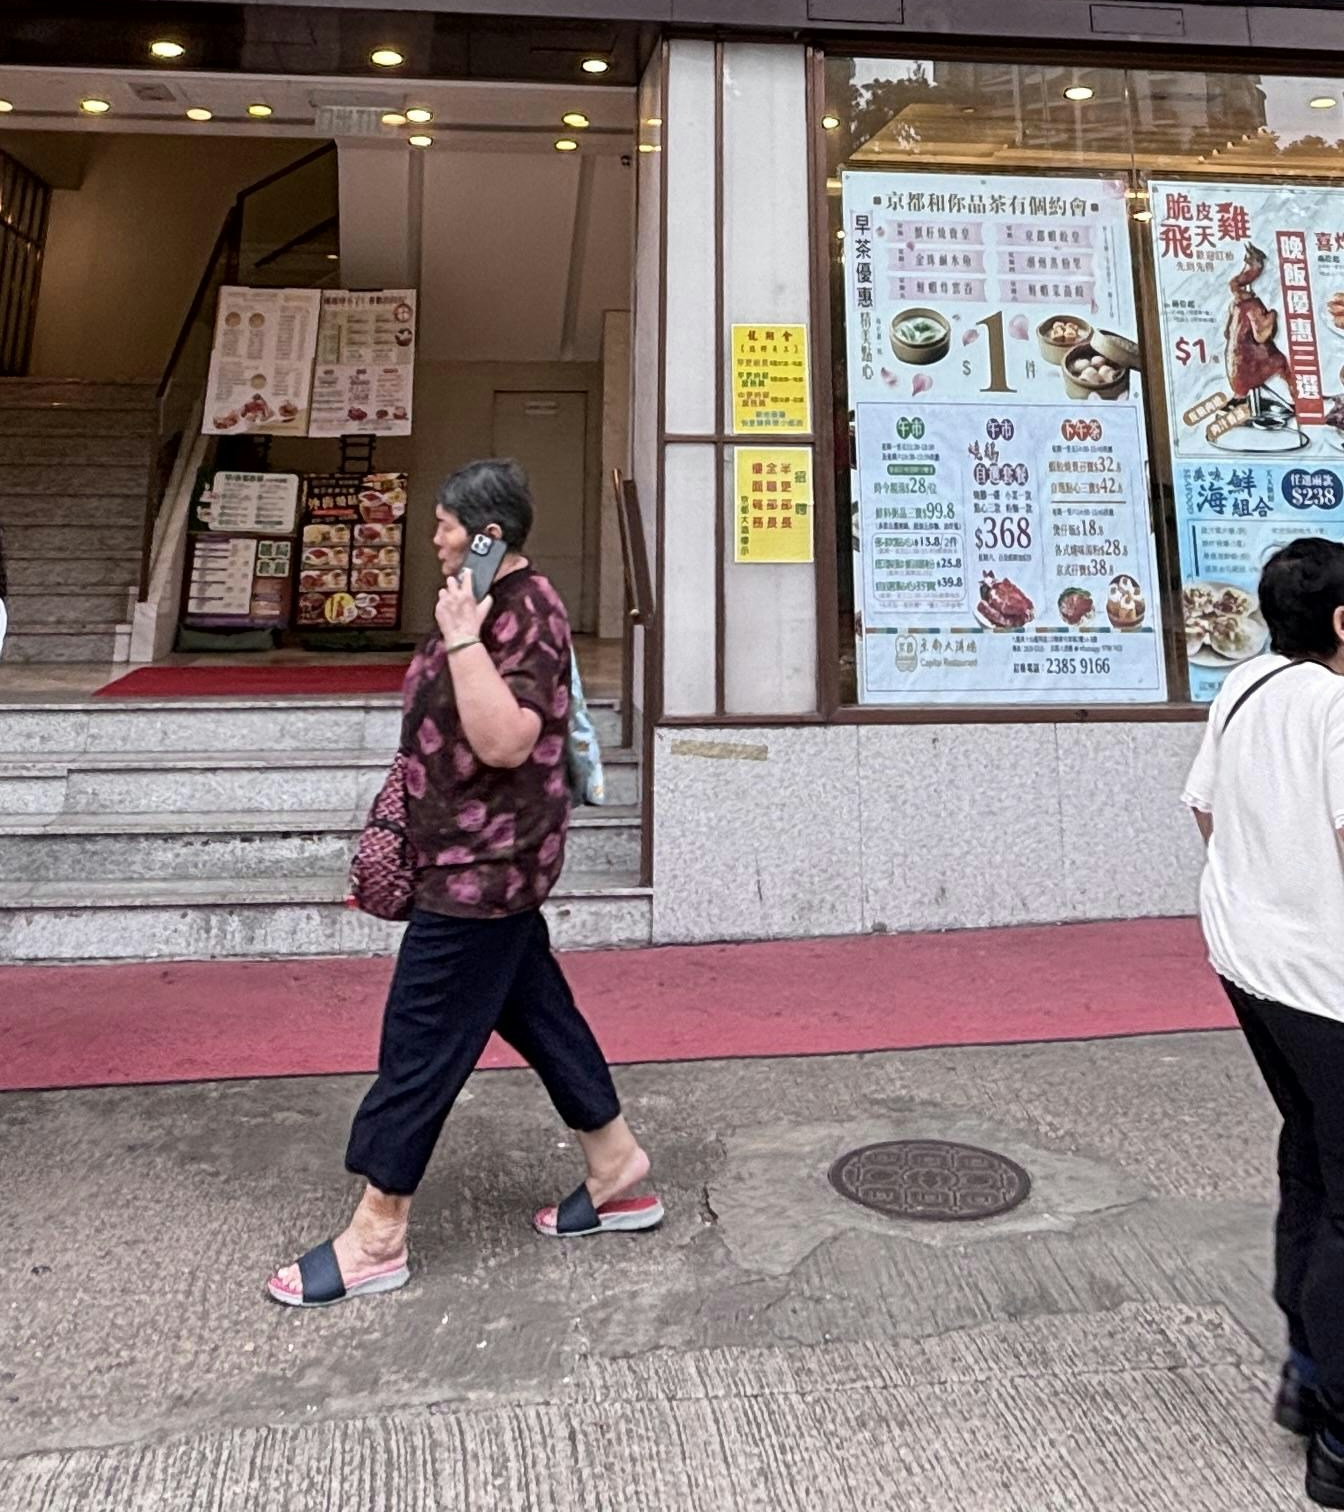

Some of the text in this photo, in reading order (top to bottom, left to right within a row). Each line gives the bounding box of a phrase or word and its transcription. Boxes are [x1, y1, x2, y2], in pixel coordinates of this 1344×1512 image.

[886, 191, 1088, 216] 京都和你品茶有個約會
[855, 215, 874, 309] 早茶優惠
[897, 418, 925, 439] 午市
[986, 418, 1014, 441] 午市
[1061, 419, 1102, 441] 下午茶
[1292, 487, 1336, 505] $238
[975, 517, 1032, 550] $368
[1046, 658, 1076, 675] 2385
[1080, 657, 1110, 674] 9166
